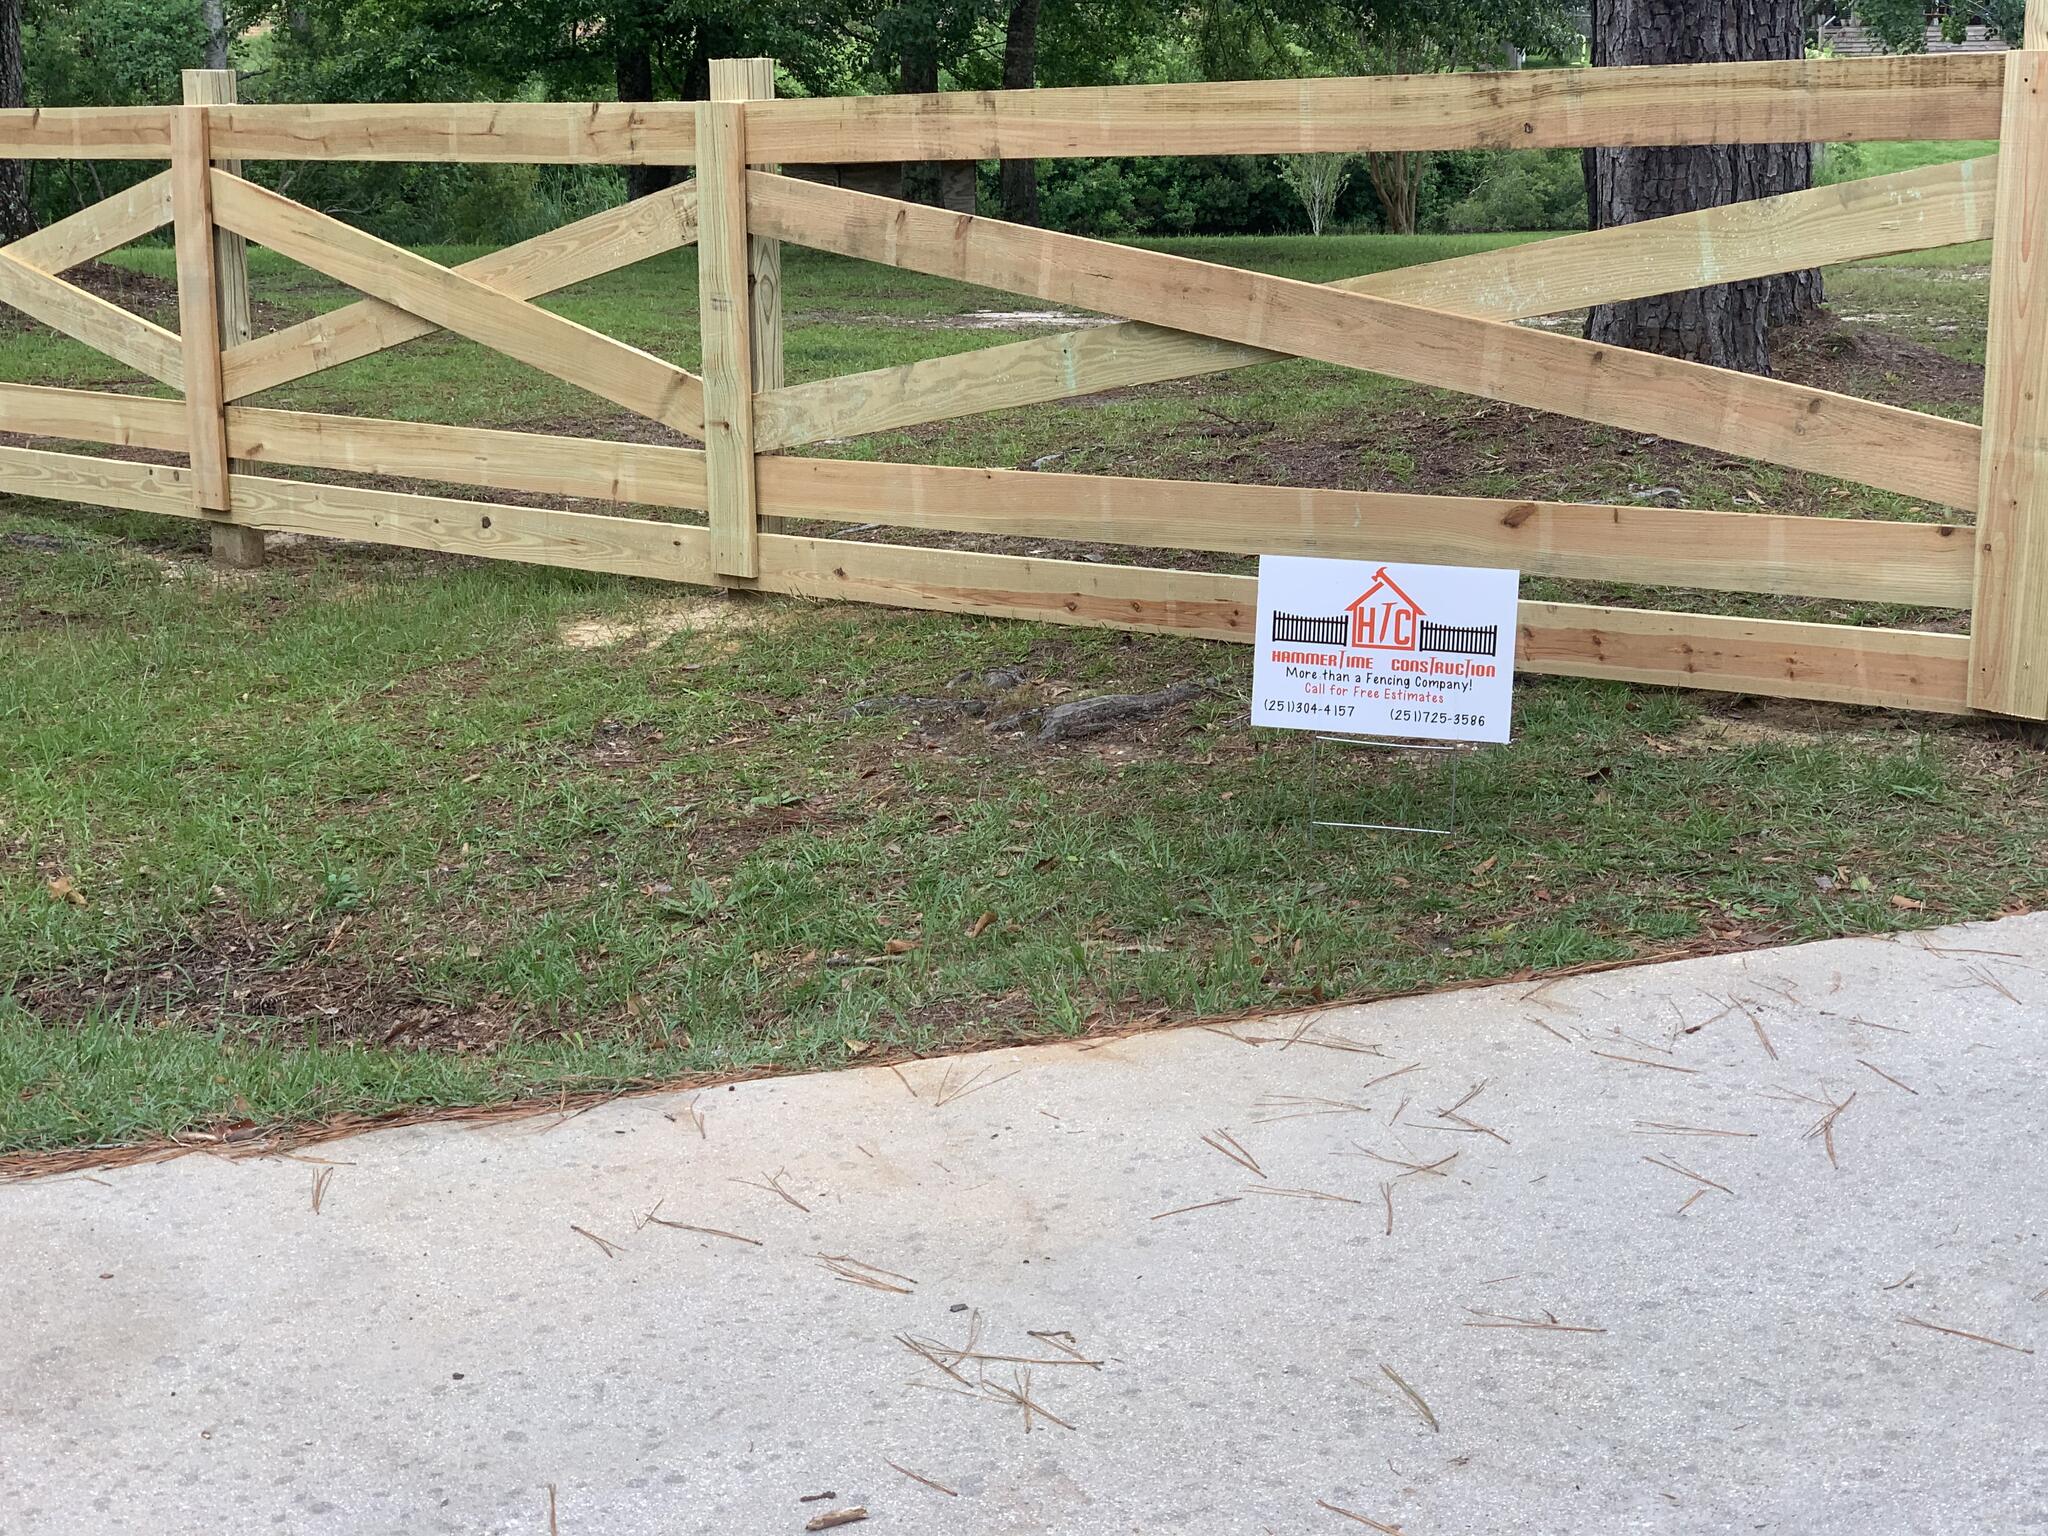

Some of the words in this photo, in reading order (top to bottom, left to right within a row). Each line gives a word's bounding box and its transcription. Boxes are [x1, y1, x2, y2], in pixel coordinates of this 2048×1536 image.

[1391, 656, 1496, 678] CONSTRUCTION
[1286, 667, 1317, 680] More
[1322, 669, 1350, 683] than
[1355, 674, 1361, 683] a
[1366, 673, 1410, 689] Fencing
[1415, 675, 1473, 692] Company!
[1305, 682, 1325, 694] Call
[1330, 684, 1349, 696] for
[1353, 686, 1379, 699] Free
[1384, 689, 1444, 704] Estimates
[1264, 699, 1355, 717] (251)304-4157
[1390, 709, 1486, 727] (251)725-3586
